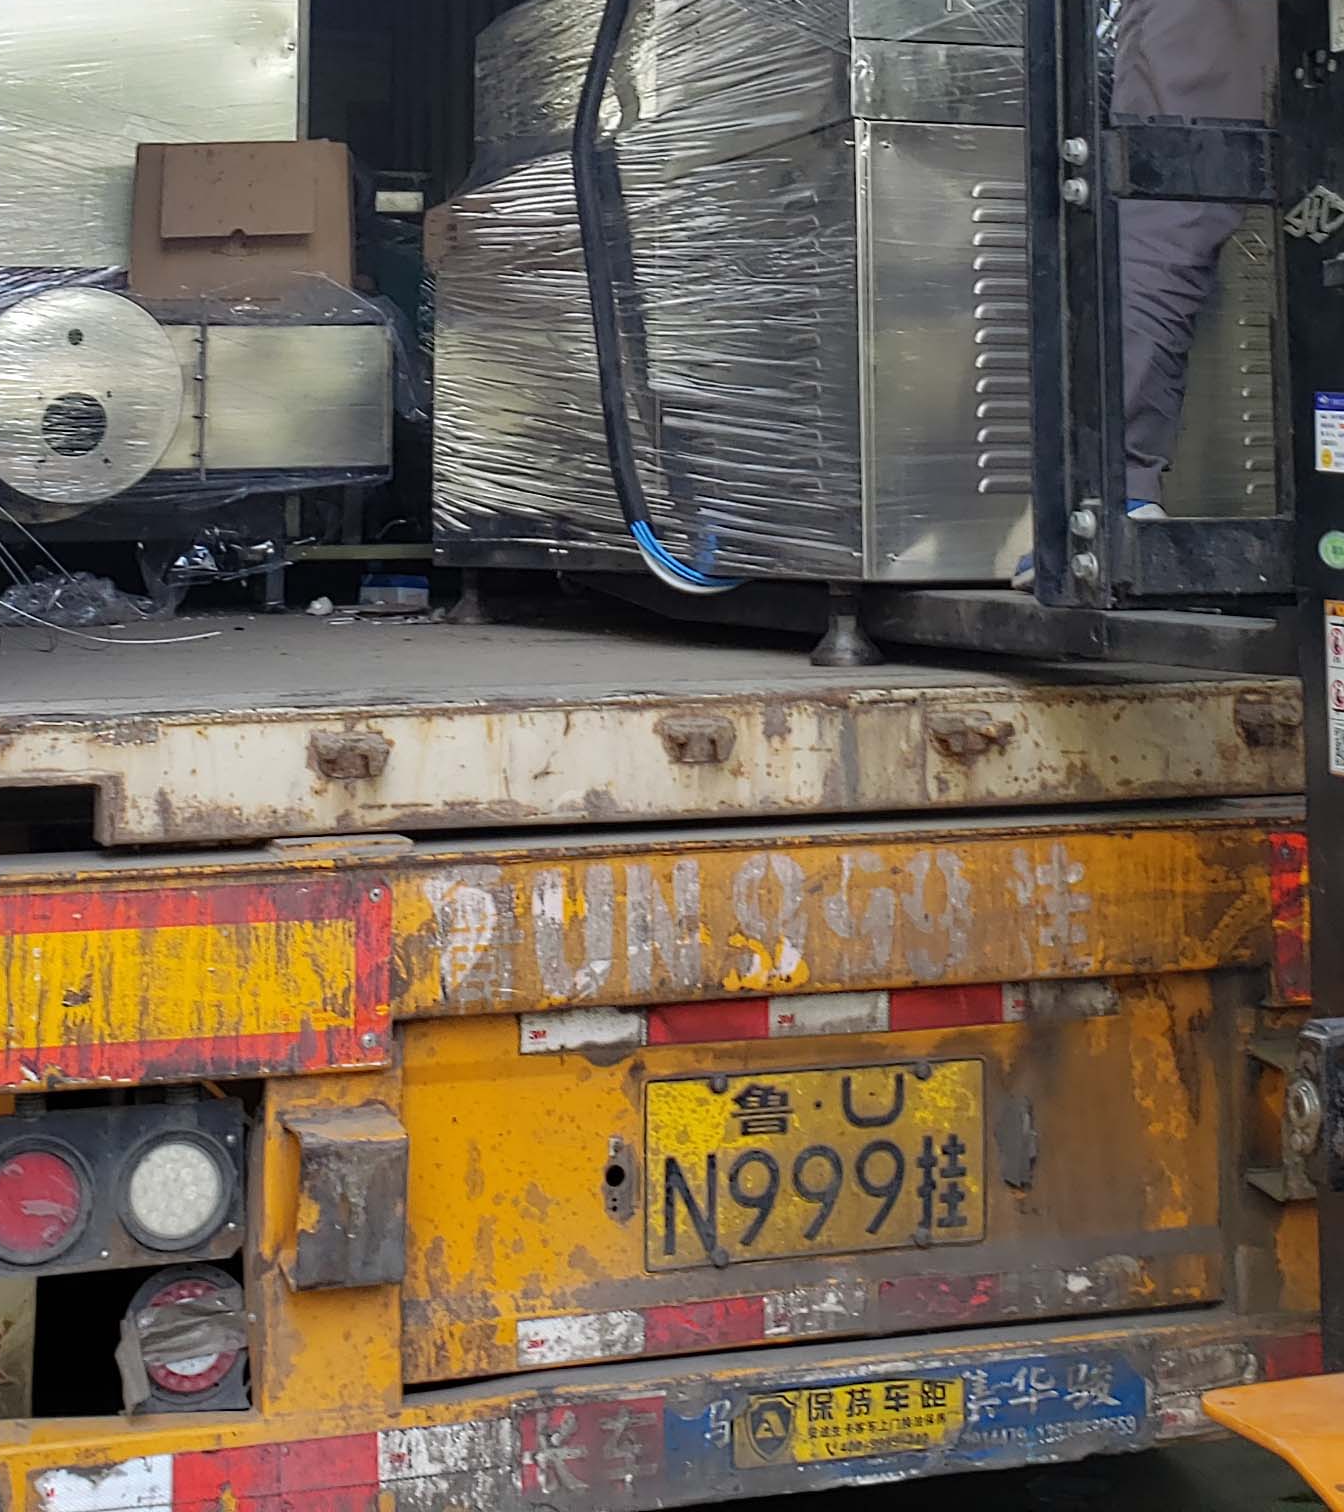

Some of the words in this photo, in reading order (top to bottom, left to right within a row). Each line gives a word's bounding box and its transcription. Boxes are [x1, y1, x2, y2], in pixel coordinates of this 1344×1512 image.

[662, 1133, 967, 1257] N999挂
[807, 1380, 947, 1422] 保持车距
